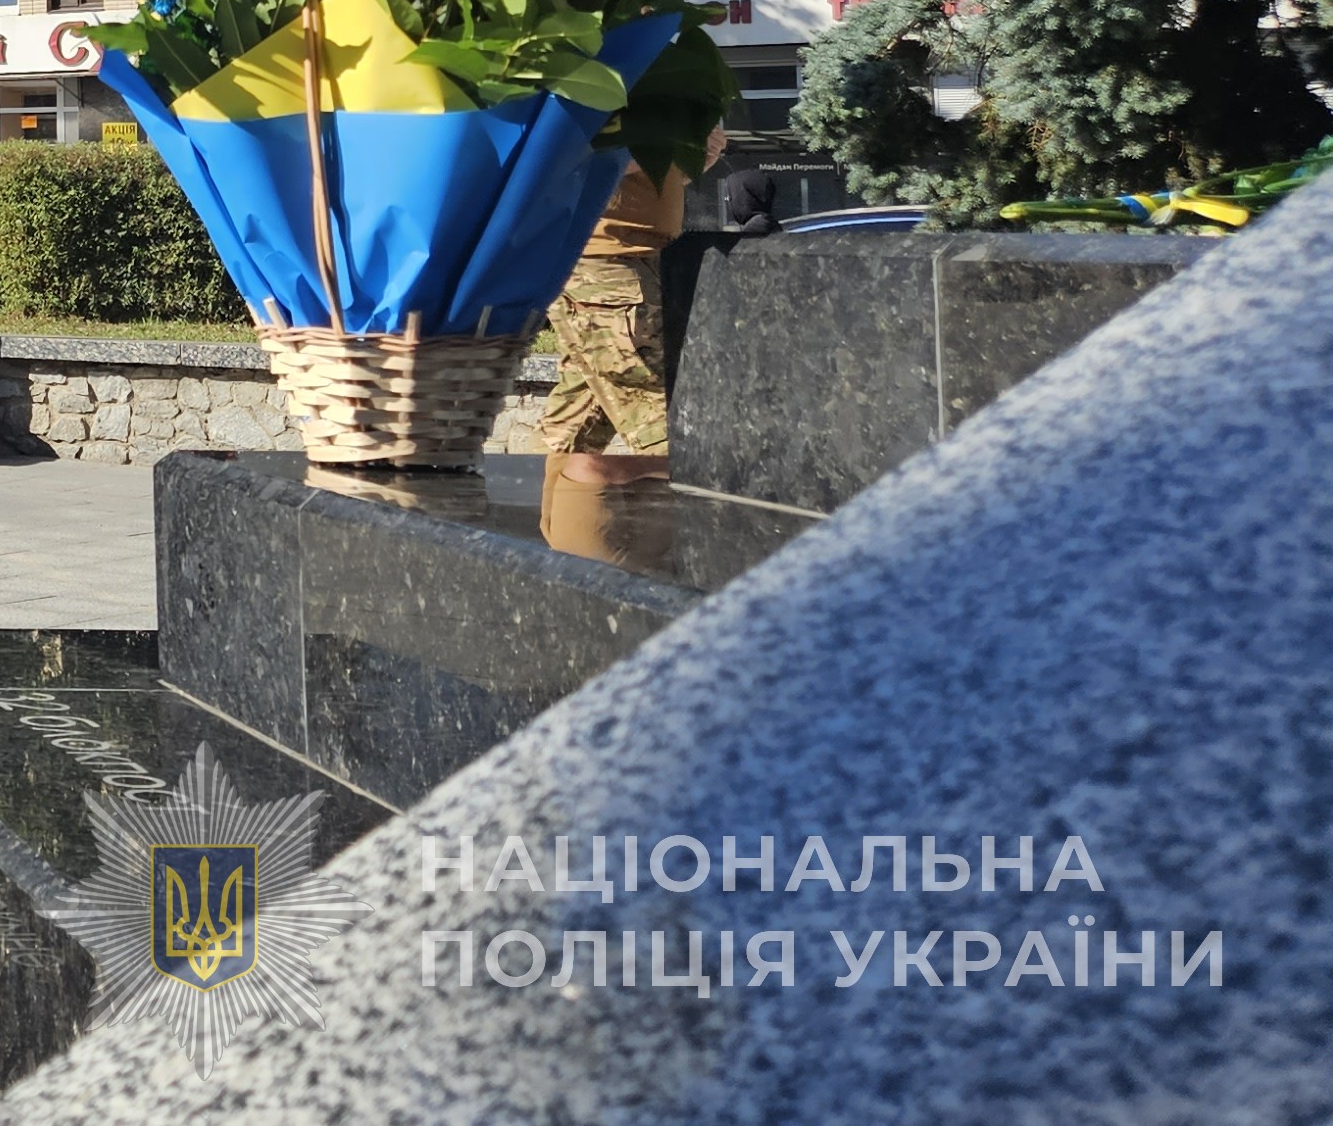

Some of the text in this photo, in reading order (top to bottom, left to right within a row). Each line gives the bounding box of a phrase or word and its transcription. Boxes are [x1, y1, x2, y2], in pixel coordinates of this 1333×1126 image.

[105, 124, 136, 135] АКЦІЯ
[759, 163, 834, 171] Майдан Перемоги
